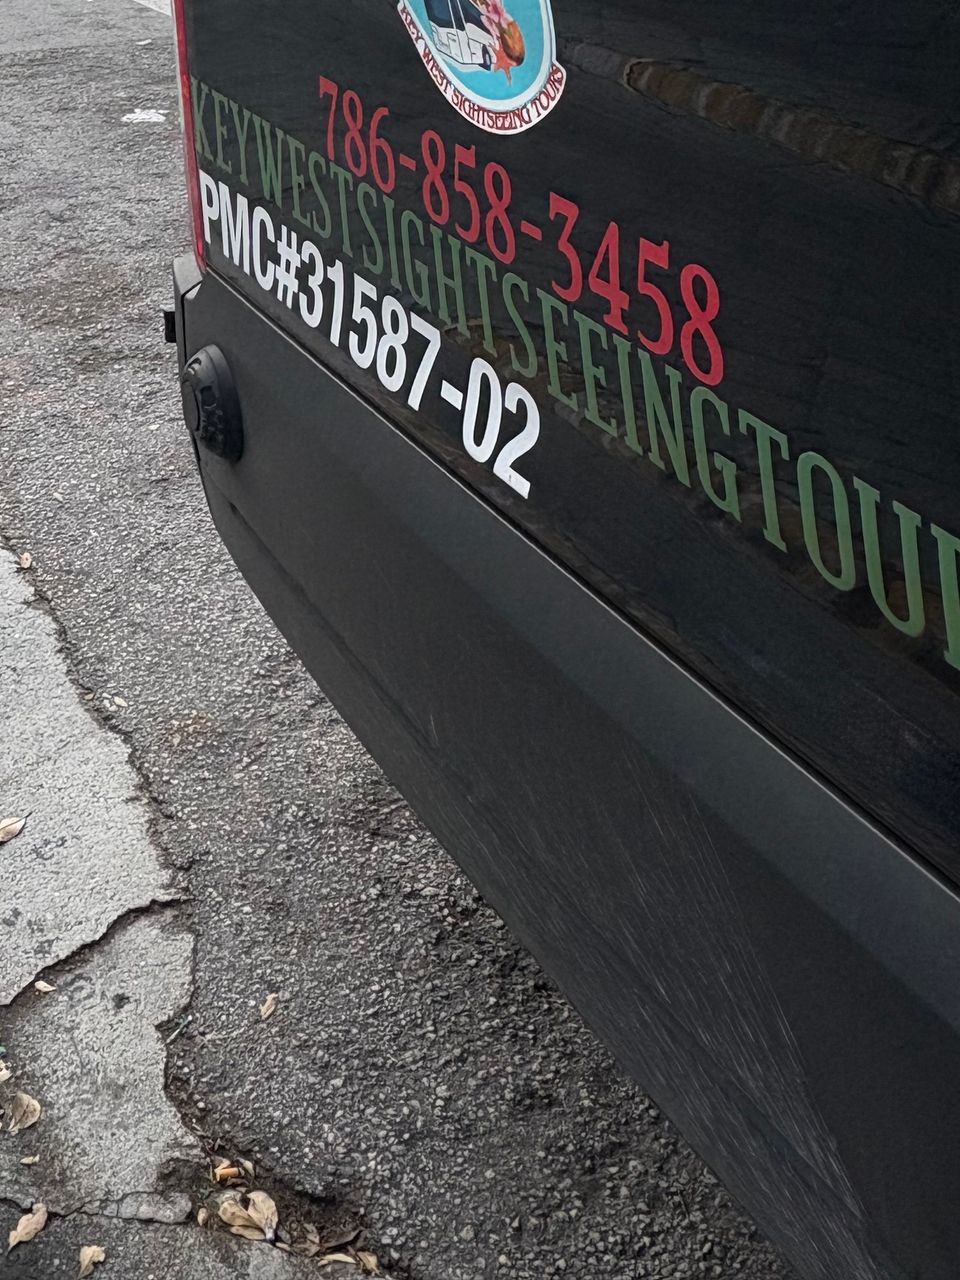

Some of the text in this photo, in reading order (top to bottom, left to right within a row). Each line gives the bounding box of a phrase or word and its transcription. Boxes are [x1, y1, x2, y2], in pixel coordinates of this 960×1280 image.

[319, 75, 724, 387] 786-858-3458
[421, 46, 450, 95] WEST
[451, 90, 532, 131] SIGHTSEEING
[531, 65, 564, 118] TOURS
[199, 169, 540, 500] PMC#31587-02
